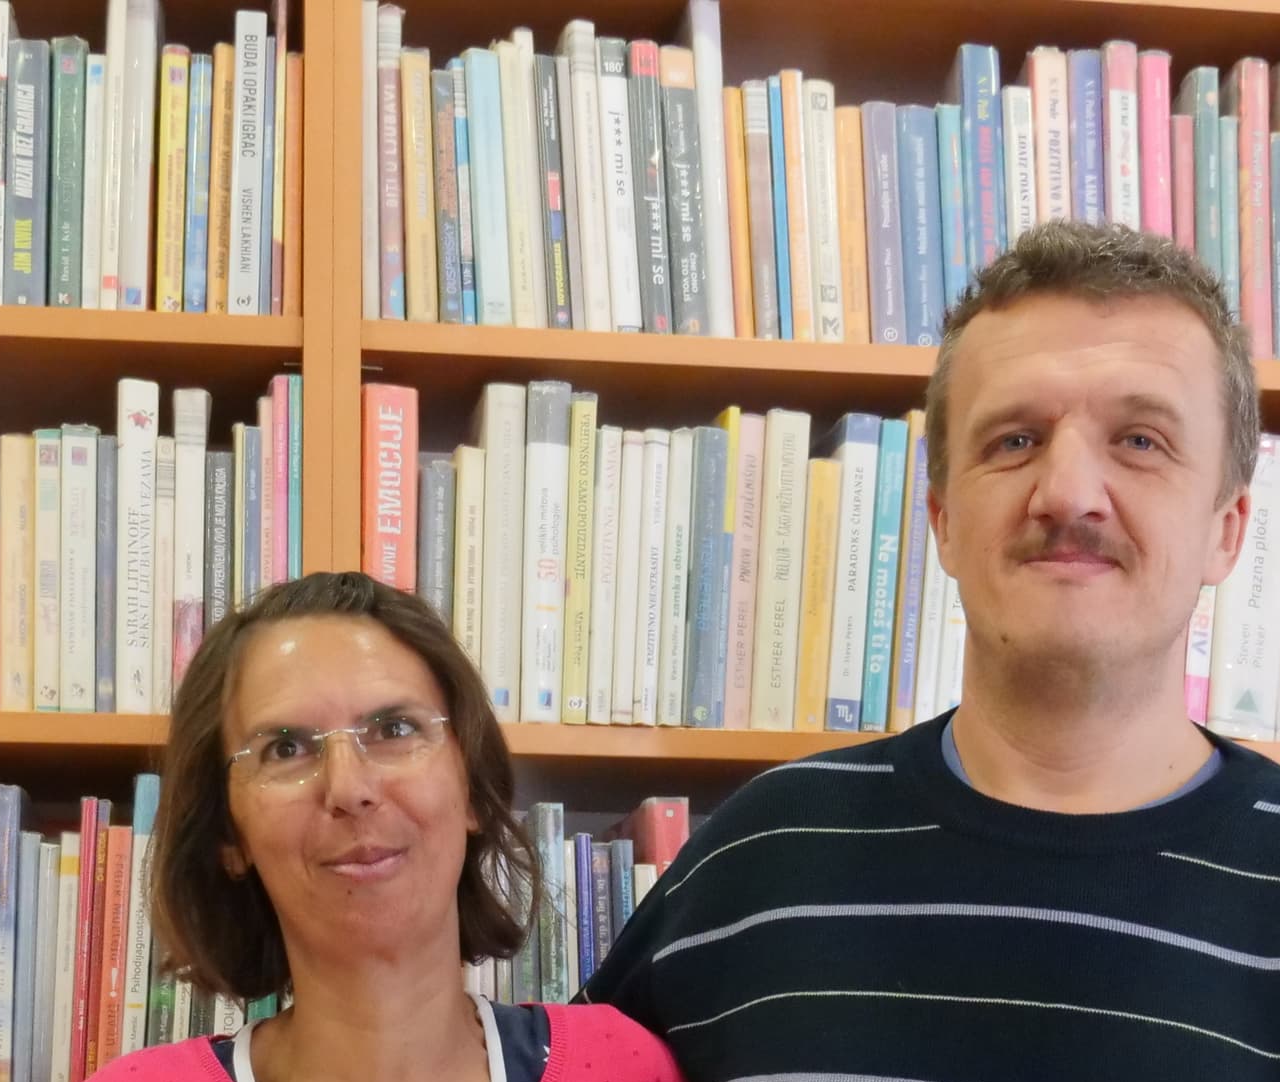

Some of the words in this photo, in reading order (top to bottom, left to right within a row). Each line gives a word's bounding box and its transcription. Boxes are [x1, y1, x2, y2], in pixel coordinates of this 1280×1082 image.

[377, 403, 404, 534] EMOCIJE
[1253, 508, 1268, 551] ploča
[1249, 557, 1264, 609] Prazna
